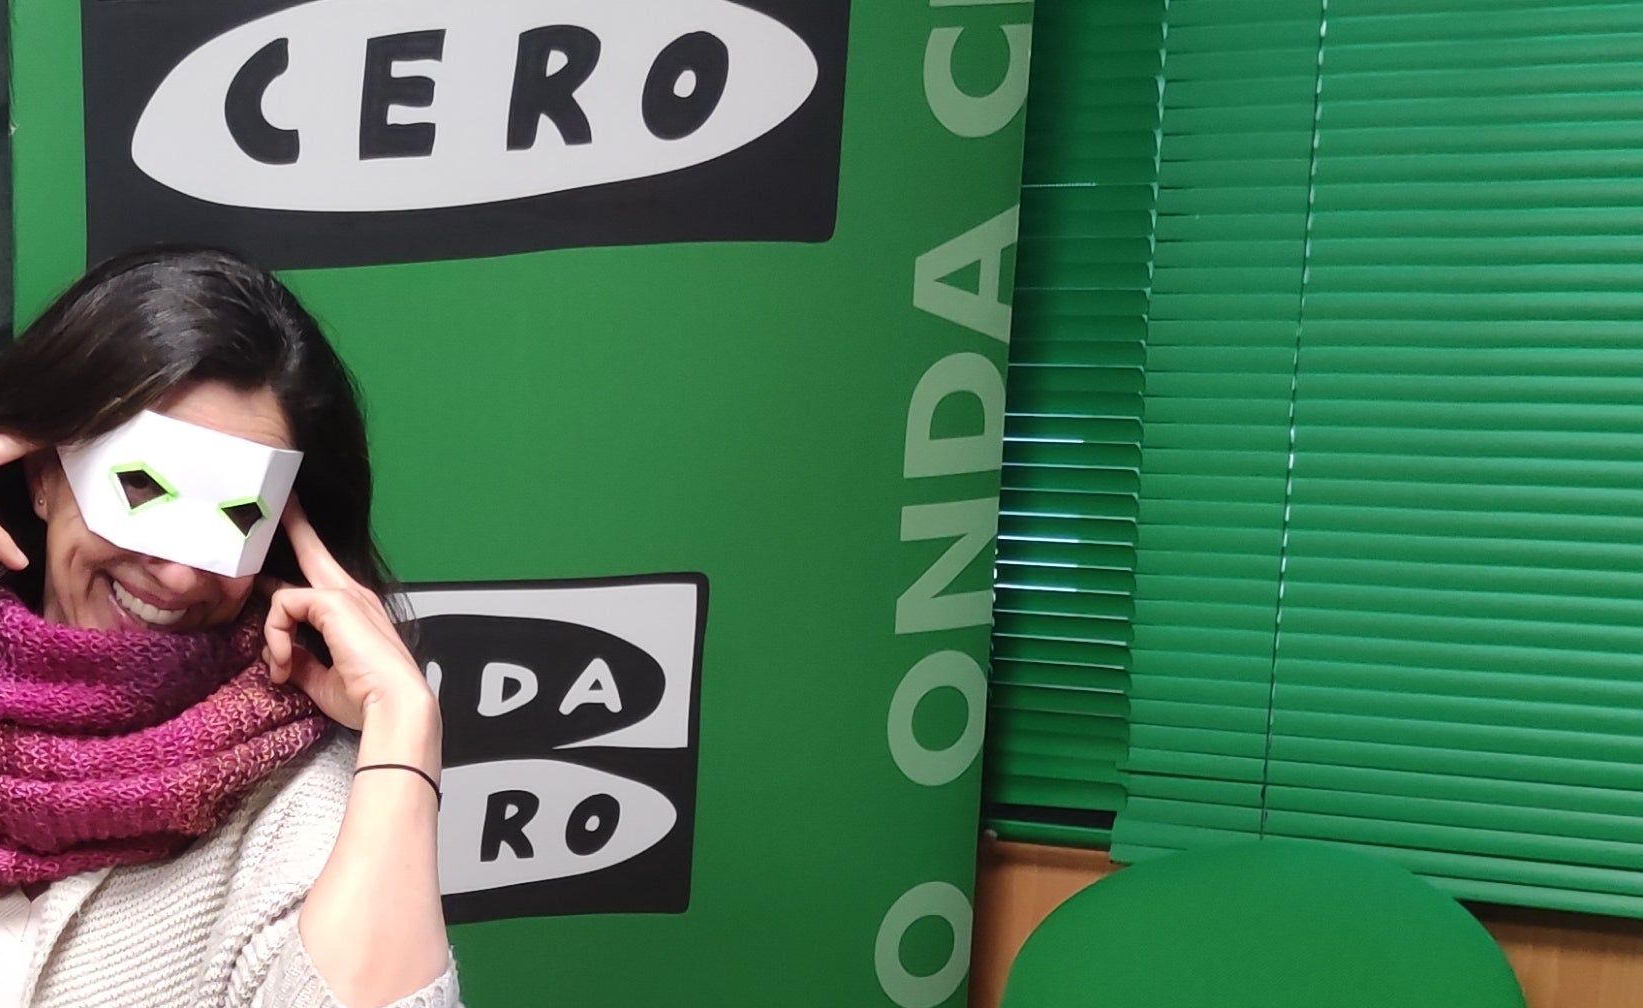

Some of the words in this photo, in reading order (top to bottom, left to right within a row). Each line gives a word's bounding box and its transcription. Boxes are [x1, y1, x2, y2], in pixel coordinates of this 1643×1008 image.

[224, 24, 730, 166] CERO
[886, 202, 1021, 787] ONDA
[425, 657, 623, 718] DA
[479, 789, 621, 863] RO
